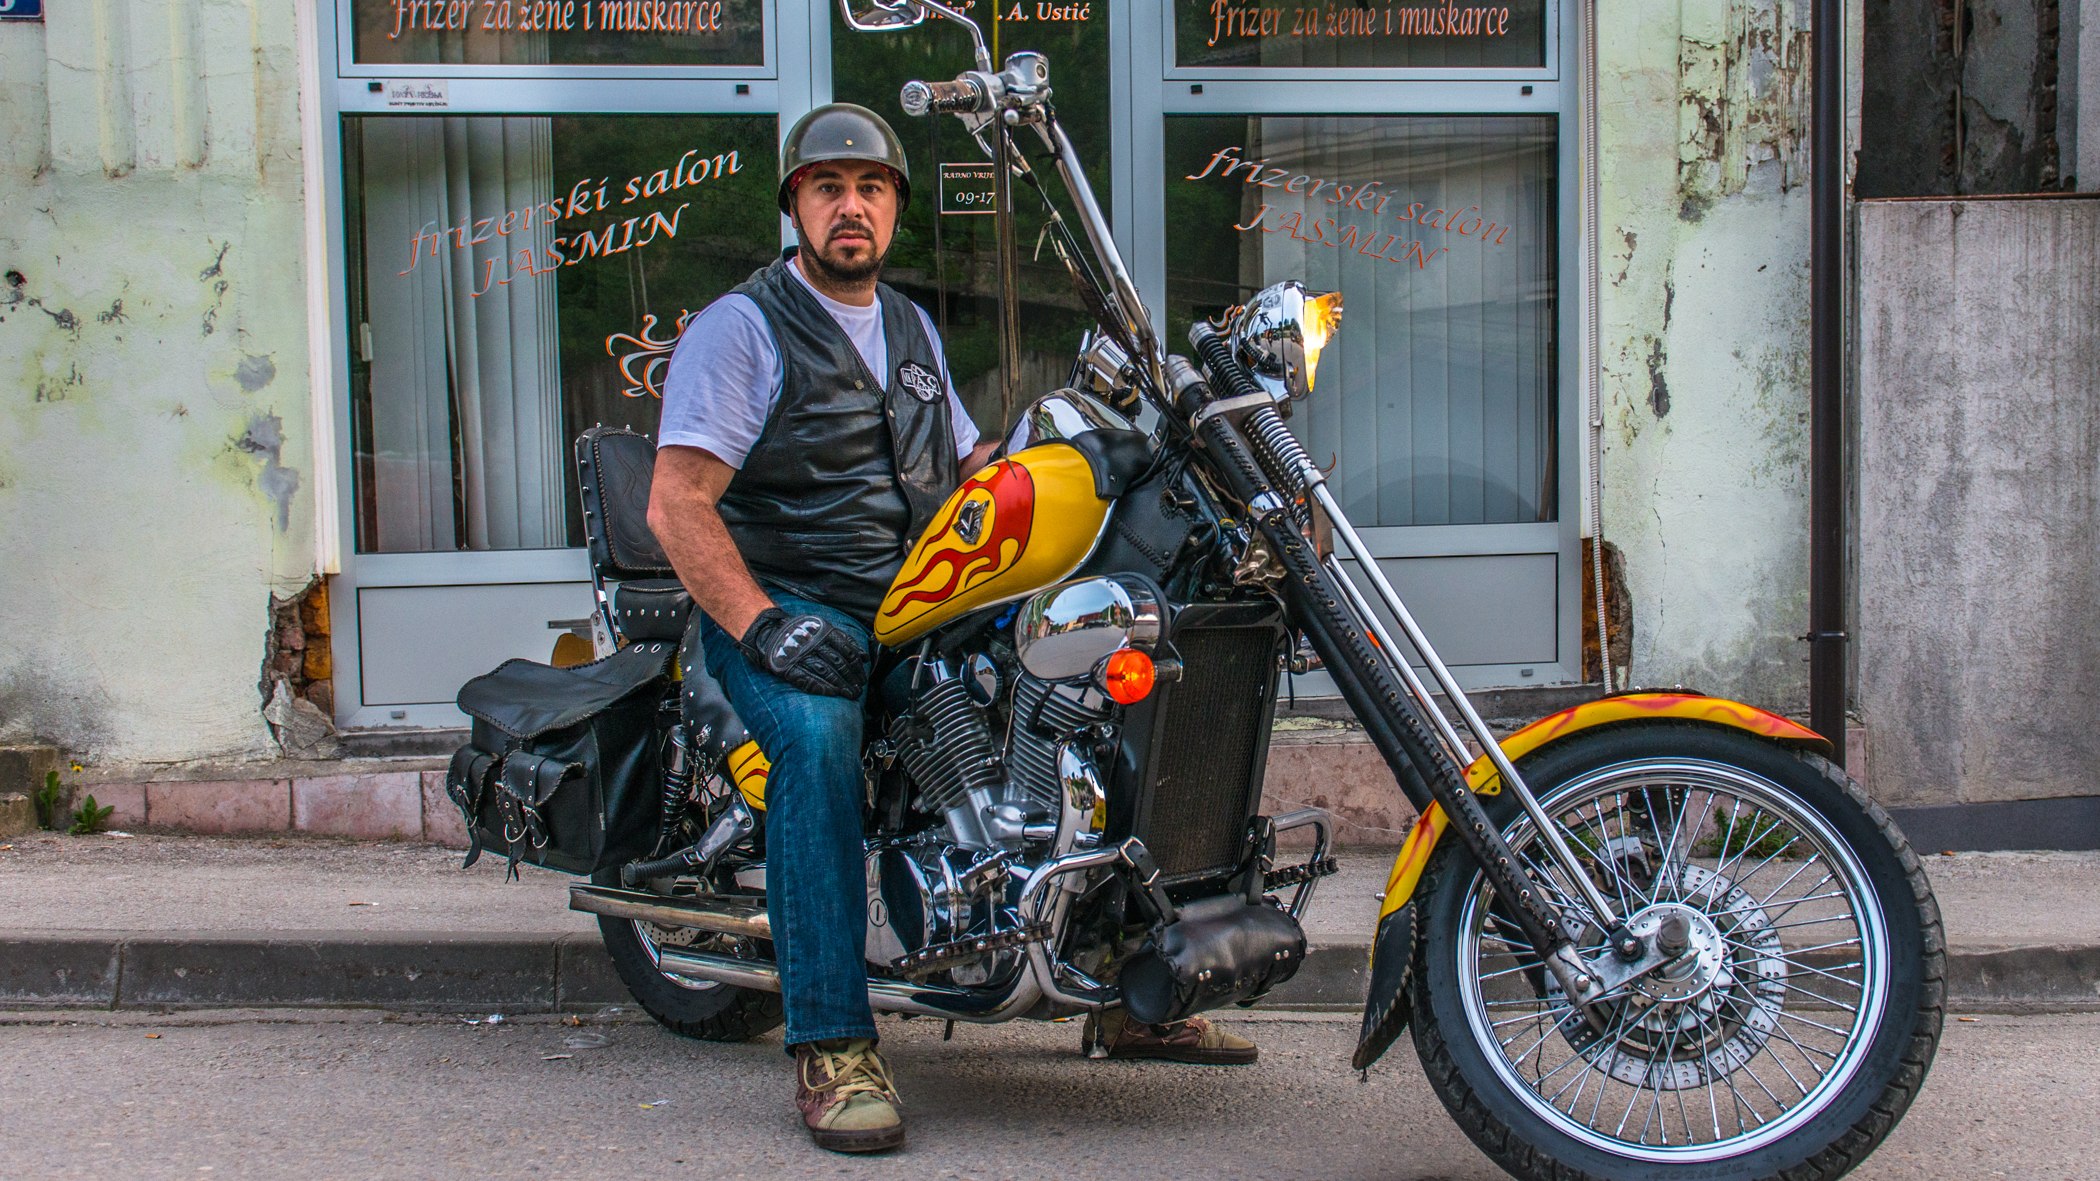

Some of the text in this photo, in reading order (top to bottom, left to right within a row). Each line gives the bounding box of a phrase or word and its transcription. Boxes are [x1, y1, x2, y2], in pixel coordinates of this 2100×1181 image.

[481, 0, 513, 31] za
[582, 0, 594, 31] i
[1036, 2, 1090, 21] Ustić
[1207, 0, 1286, 47] Frizer
[1291, 7, 1320, 36] za
[1325, 1, 1376, 37] žene
[1384, 0, 1394, 36] i
[399, 149, 743, 276] frizerski salon
[955, 191, 996, 205] 09-17
[1185, 146, 1512, 245] frizerski salon
[471, 202, 690, 297] JASMIN
[1233, 203, 1449, 270] JASMIN
